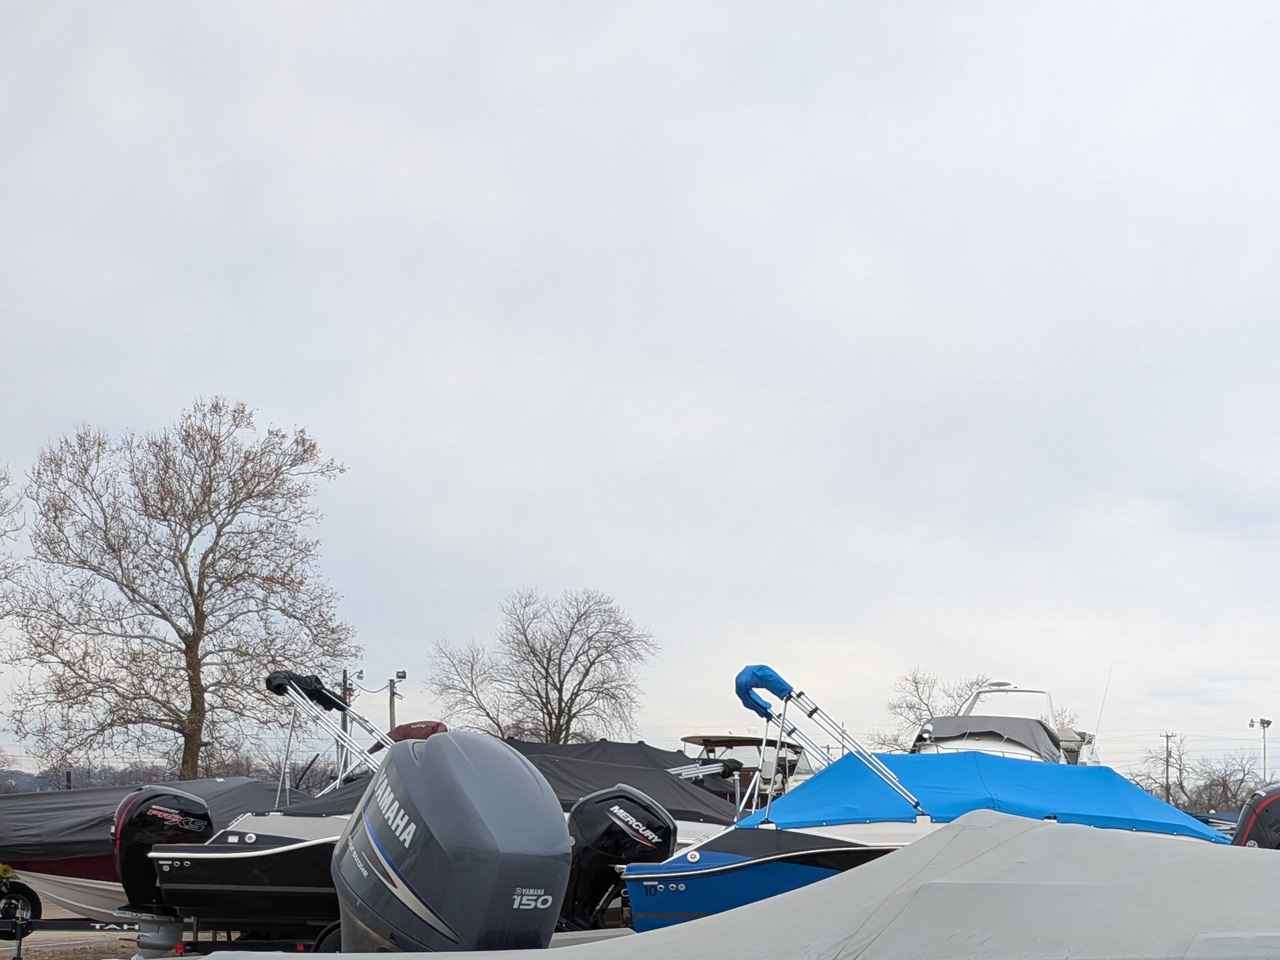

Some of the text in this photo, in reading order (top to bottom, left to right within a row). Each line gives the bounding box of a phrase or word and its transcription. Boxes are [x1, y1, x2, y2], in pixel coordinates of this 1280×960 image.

[374, 767, 417, 849] YAMAHA
[610, 805, 663, 842] MERCURY
[512, 895, 553, 909] 150
